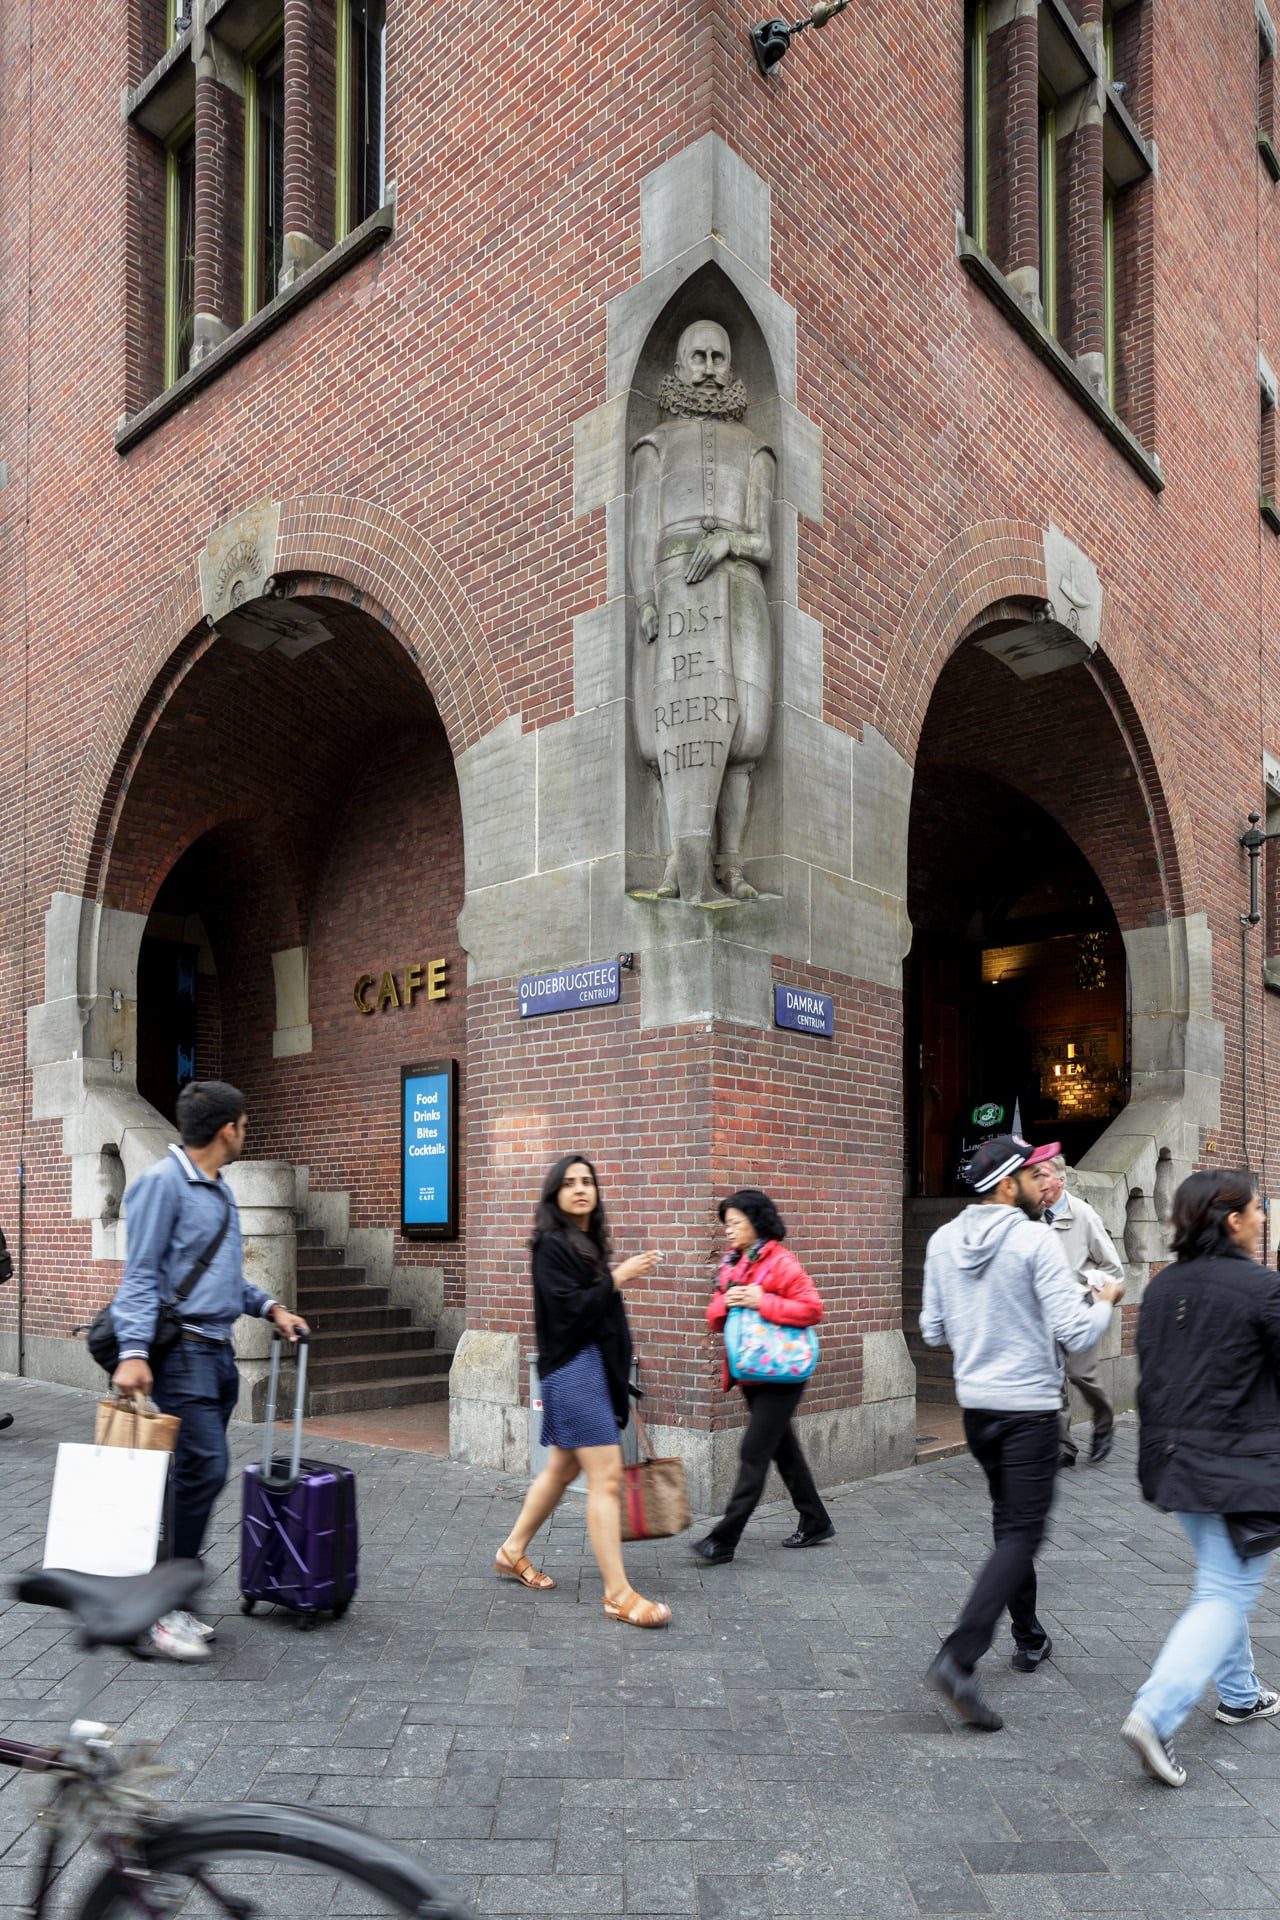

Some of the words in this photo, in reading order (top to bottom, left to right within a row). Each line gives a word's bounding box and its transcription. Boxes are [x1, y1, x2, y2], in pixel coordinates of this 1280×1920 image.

[672, 651, 716, 682] PE-
[654, 696, 737, 732] REERT
[663, 740, 724, 776] NIET
[353, 958, 446, 1013] CAFE
[520, 967, 615, 999] OUDEBRUGSTEEG
[579, 987, 616, 1002] CENTRUM
[786, 992, 825, 1016] DAMRAK
[797, 1014, 825, 1029] CENTRUM
[416, 1092, 438, 1105] Food
[413, 1109, 441, 1122] Drinks
[416, 1128, 438, 1139] Bites
[408, 1143, 446, 1156] Cocktails
